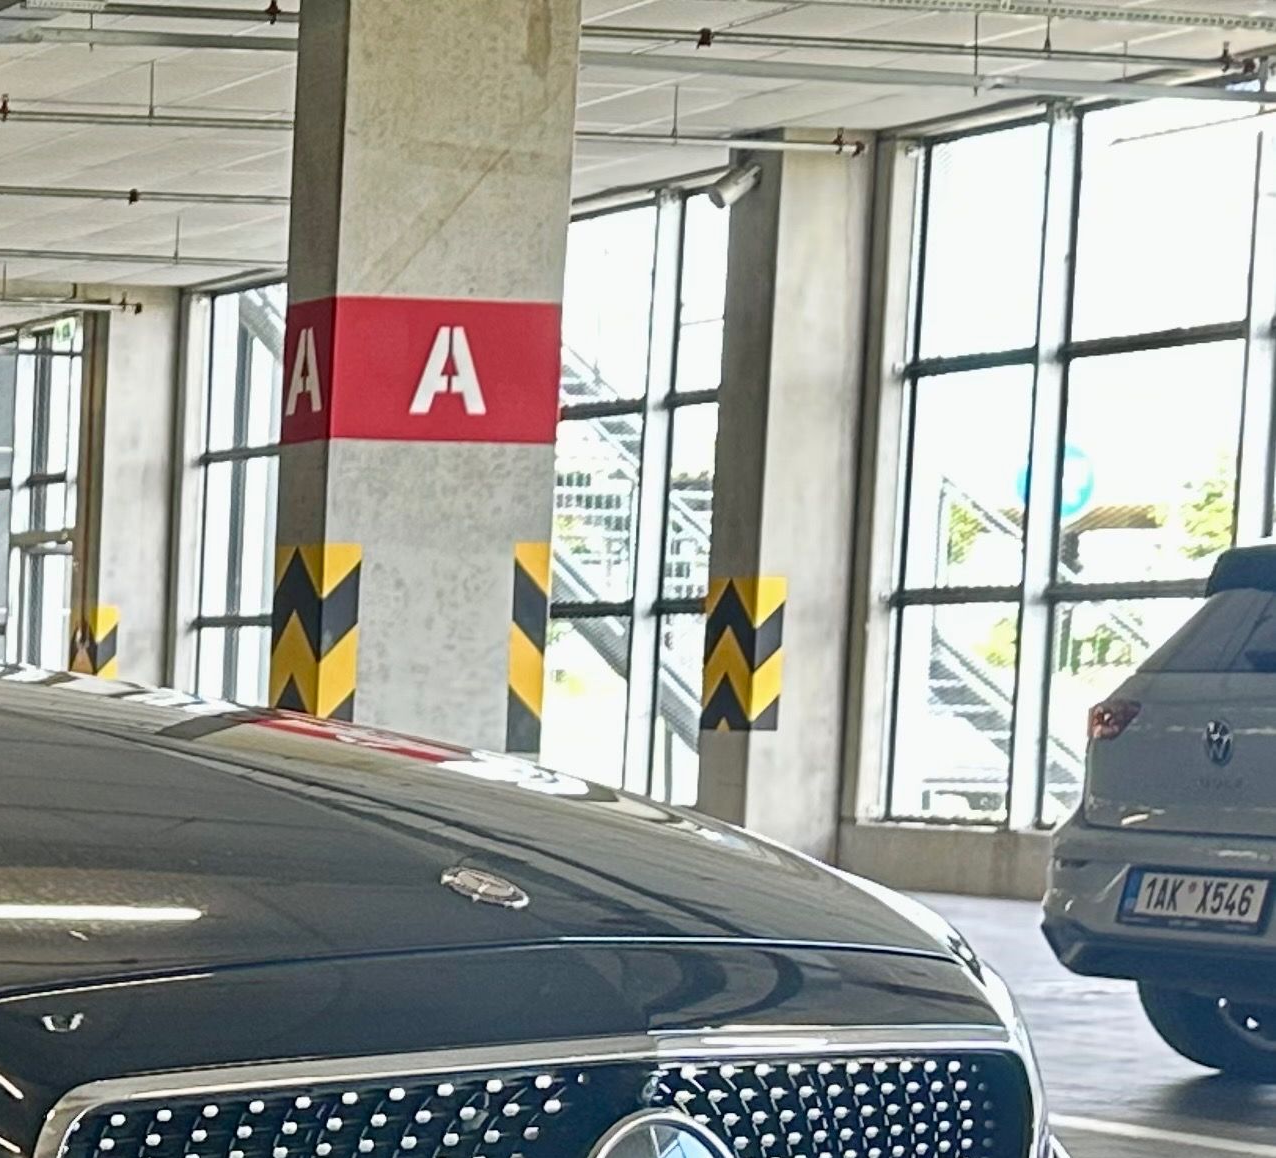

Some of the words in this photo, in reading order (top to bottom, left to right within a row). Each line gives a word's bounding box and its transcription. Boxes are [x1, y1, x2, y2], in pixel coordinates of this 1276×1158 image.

[286, 327, 322, 416] A
[409, 326, 487, 415] A
[1146, 877, 1185, 911] 1AK
[1196, 880, 1255, 916] X546
